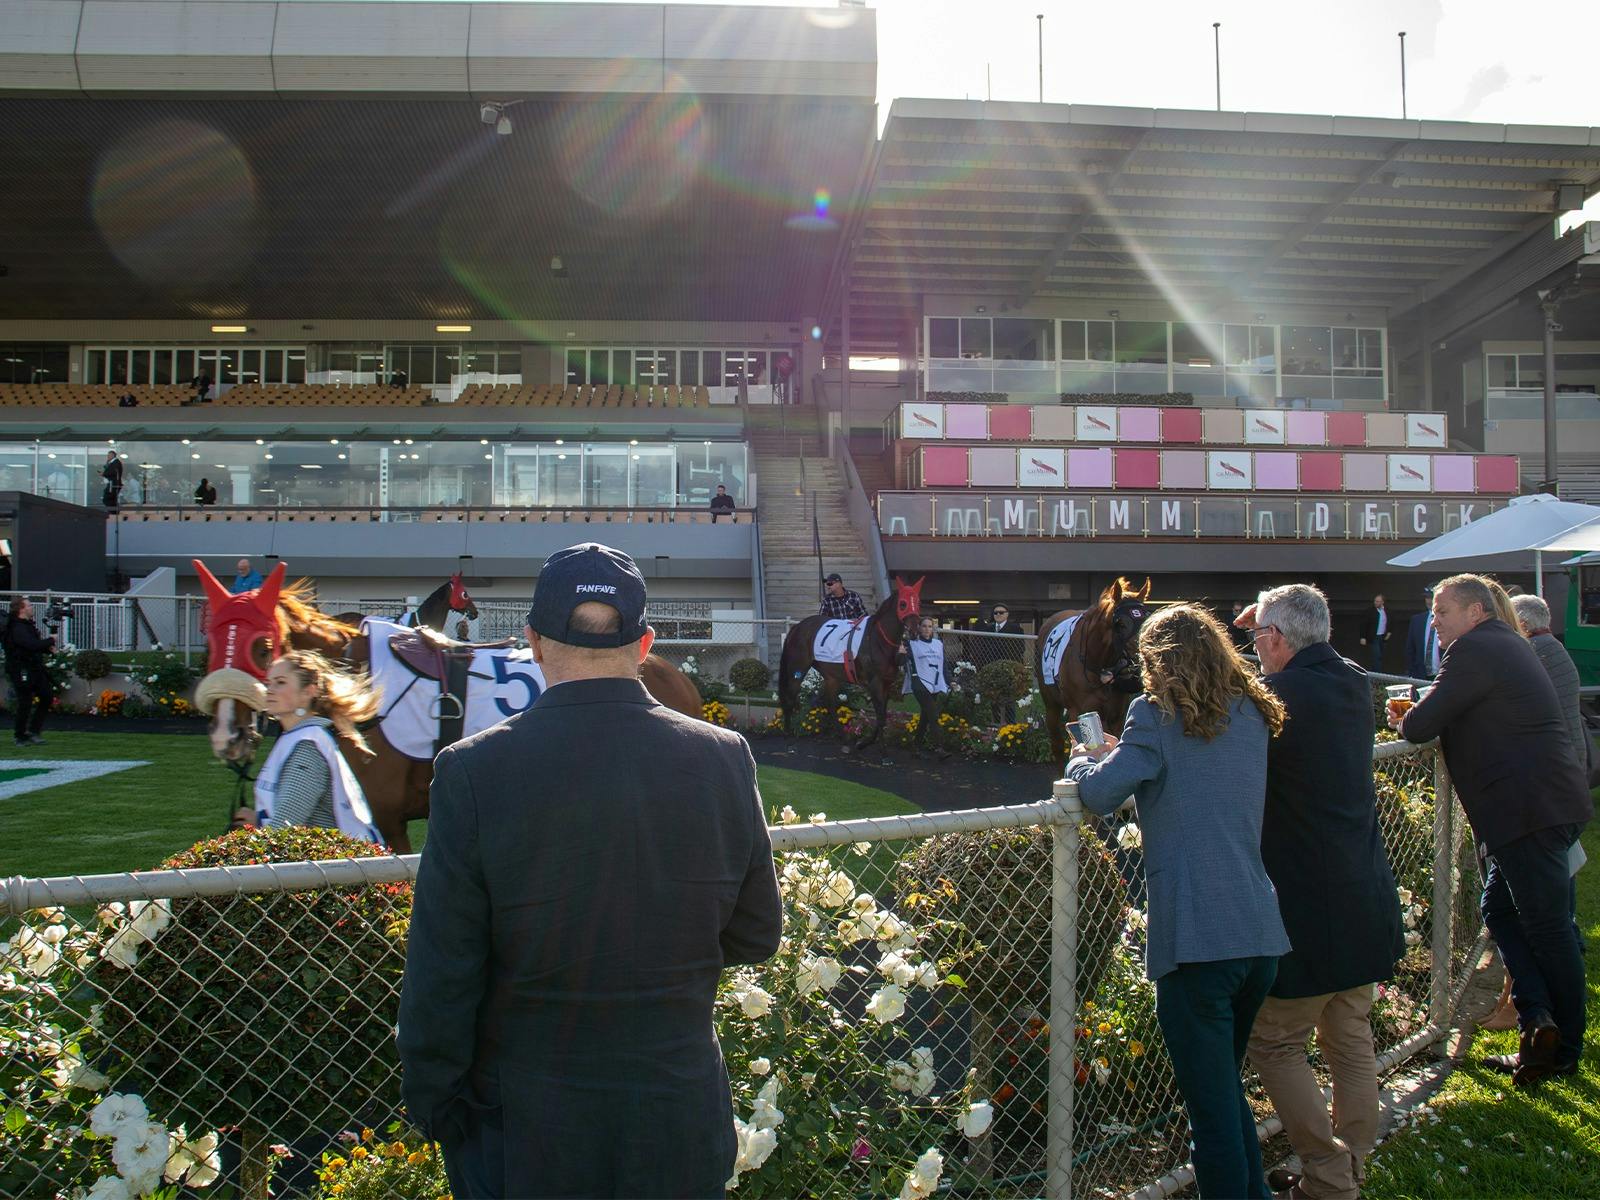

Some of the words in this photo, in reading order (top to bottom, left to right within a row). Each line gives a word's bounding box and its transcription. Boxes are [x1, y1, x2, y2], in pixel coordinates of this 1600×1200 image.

[1004, 499, 1181, 531] MUMM
[1315, 502, 1475, 534] DECK
[575, 584, 617, 595] FANFAVE
[819, 623, 839, 647] 7
[491, 655, 542, 717] 5
[928, 663, 940, 686] 7
